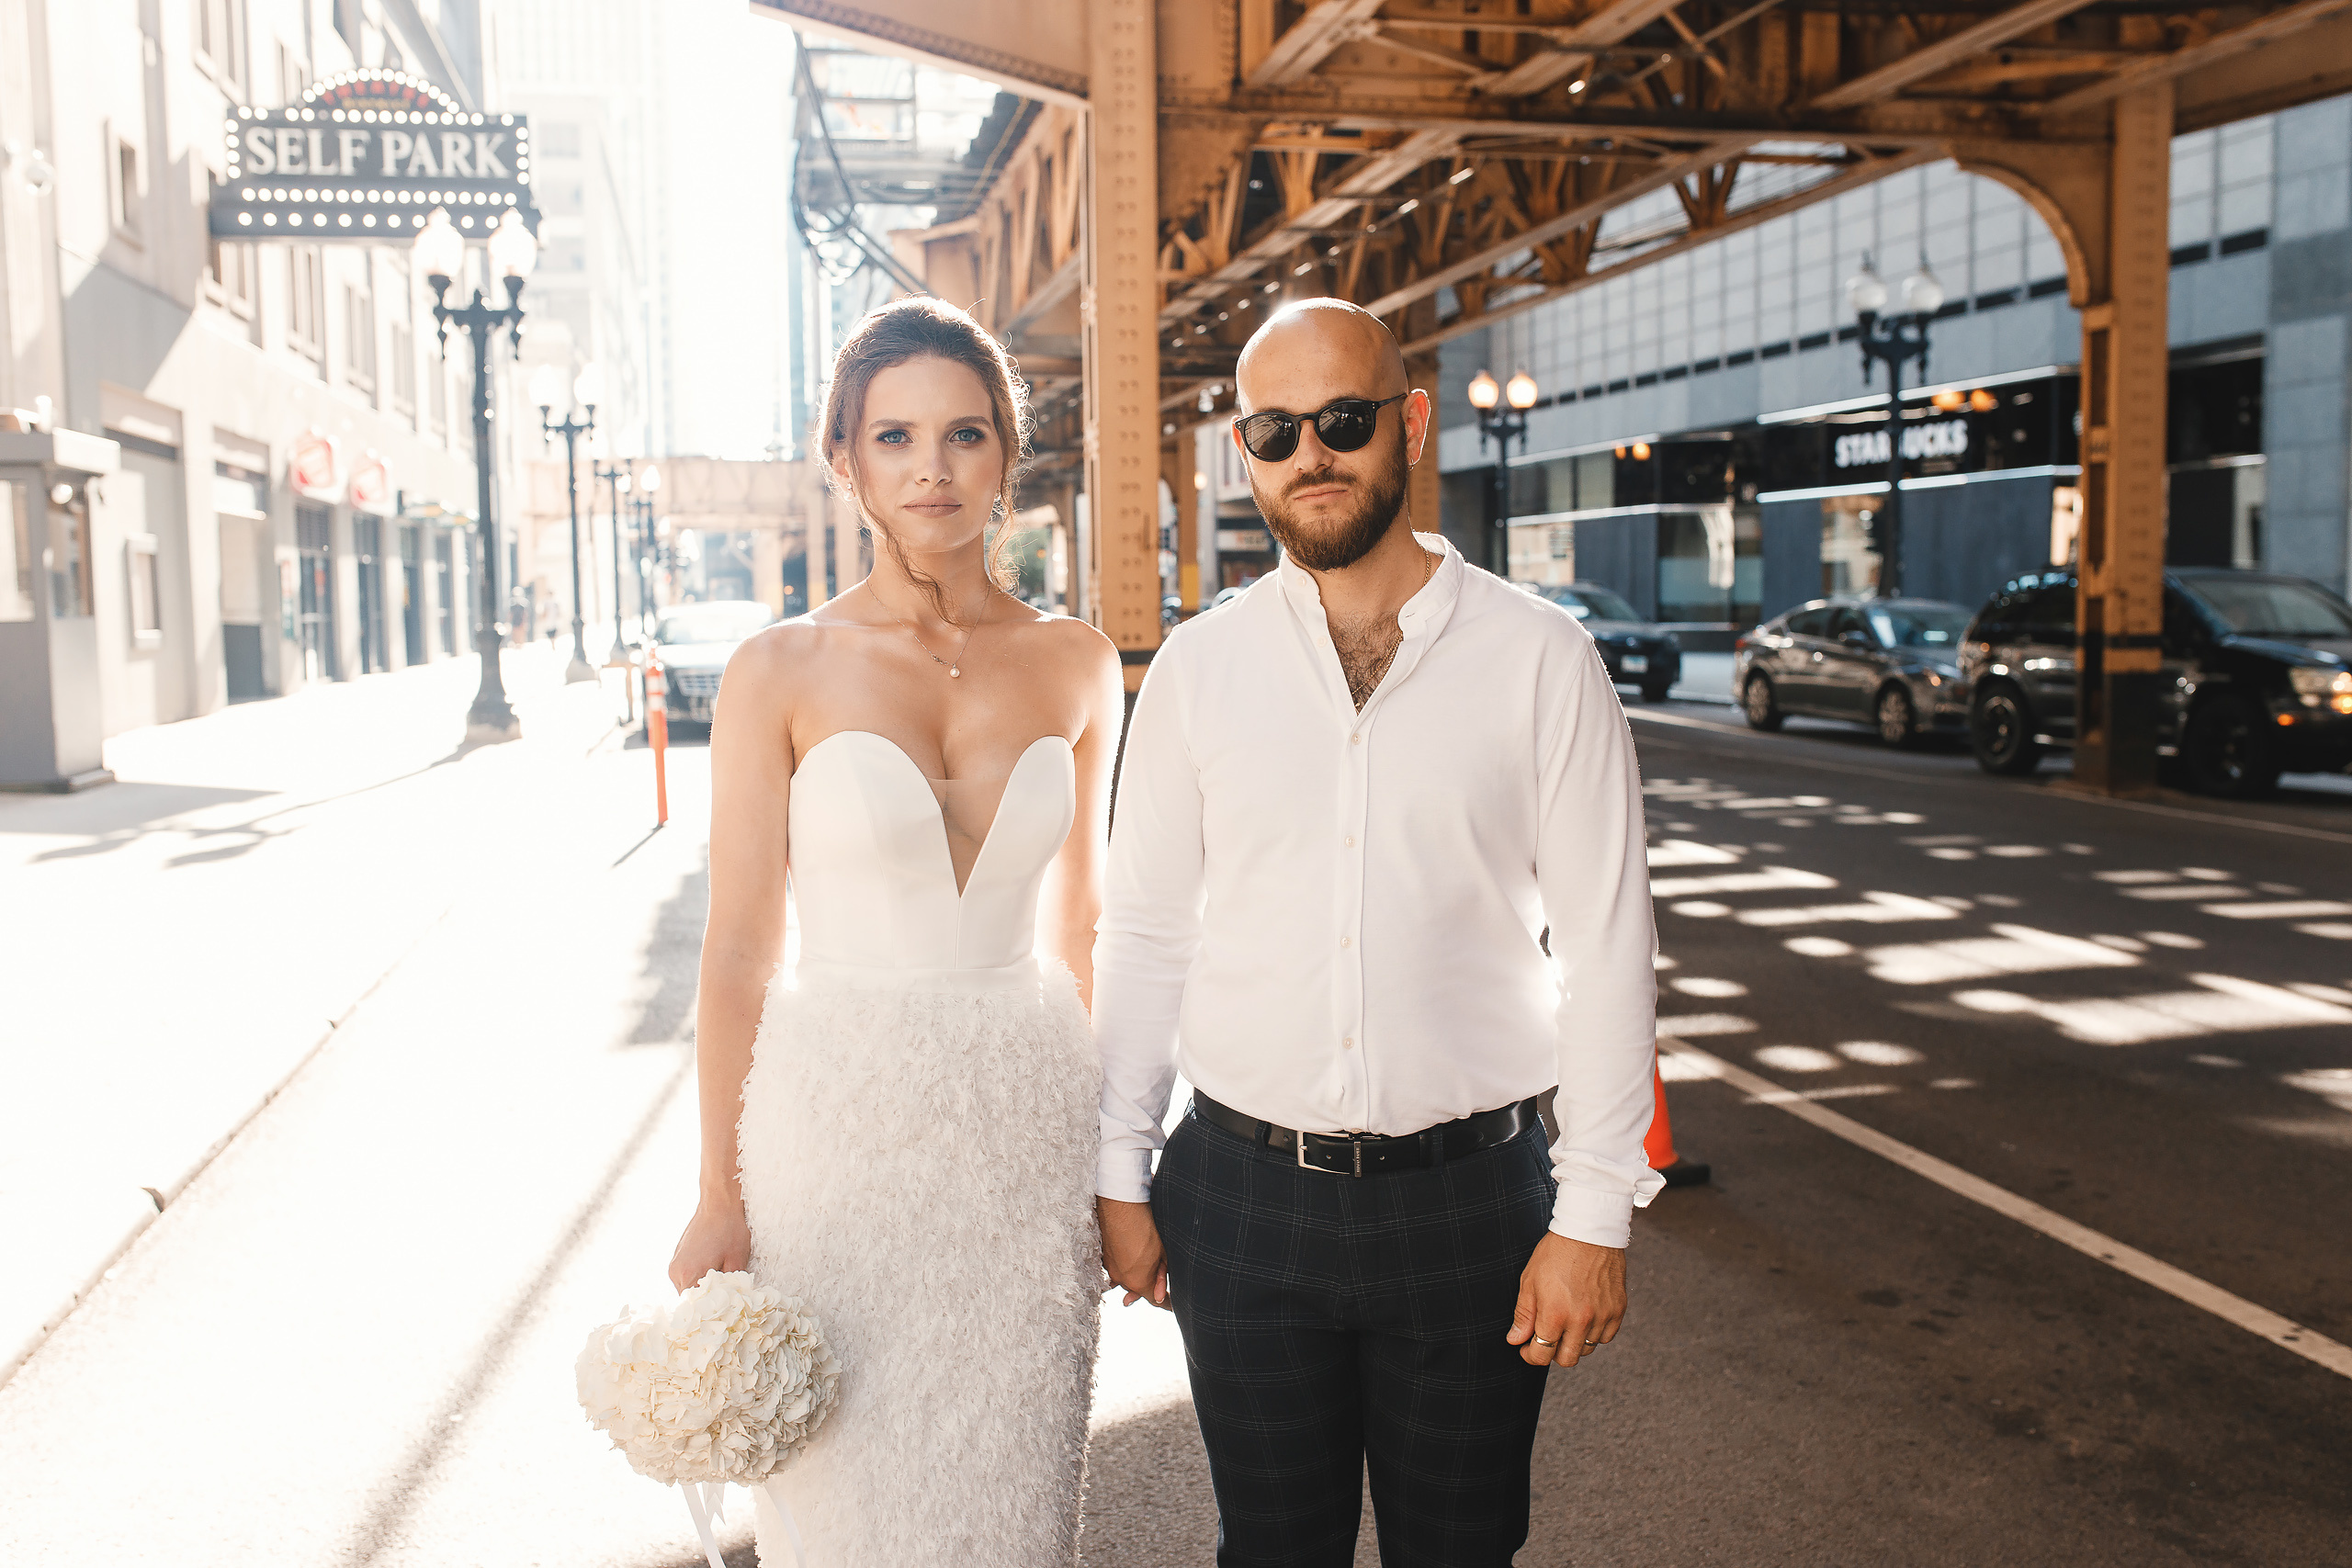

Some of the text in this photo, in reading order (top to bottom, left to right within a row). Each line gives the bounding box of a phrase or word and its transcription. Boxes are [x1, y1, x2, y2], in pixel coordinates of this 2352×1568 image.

[244, 126, 512, 179] SELF PARK
[1835, 419, 1969, 468] STARUCKS
